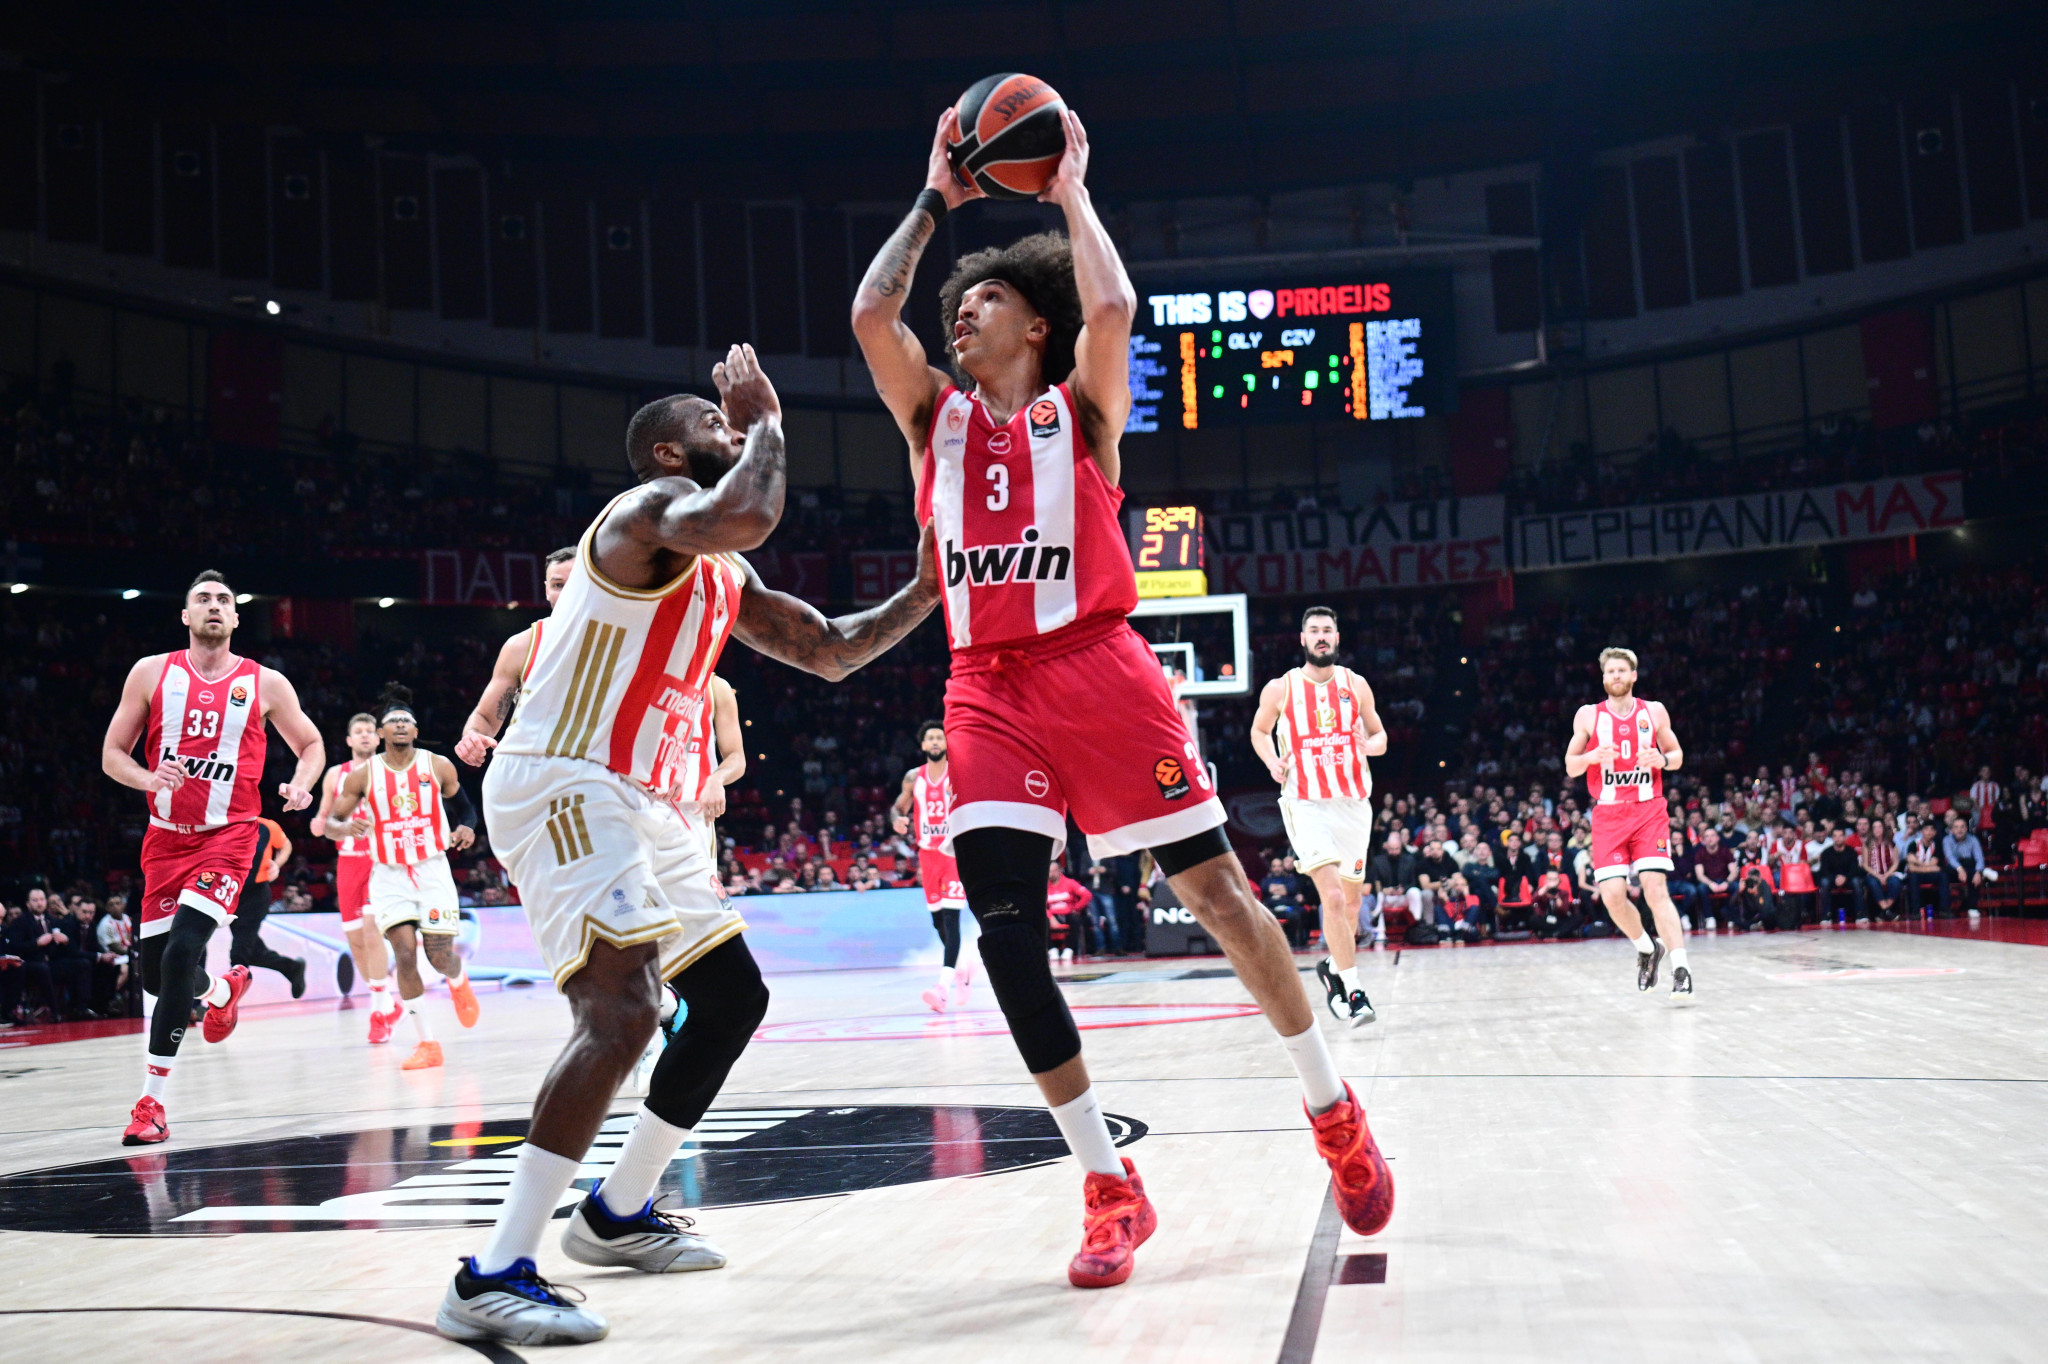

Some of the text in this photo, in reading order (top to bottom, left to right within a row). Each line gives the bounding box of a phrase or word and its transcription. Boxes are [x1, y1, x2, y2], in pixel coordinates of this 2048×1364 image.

[993, 82, 1056, 122] SPALD
[1149, 293, 1212, 326] THIS
[1218, 290, 1247, 322] IS
[1228, 328, 1315, 350] OLY CZV
[1243, 374, 1256, 392] 7
[986, 464, 1009, 512] 3
[1146, 506, 1196, 532] 5:29
[1519, 473, 1965, 568] ΠΕΡΗΦΑΝΙΑ ΜΑΣ
[946, 528, 1071, 588] bwin
[1139, 533, 1190, 567] 21
[424, 550, 540, 604] ΠΑΠ
[187, 708, 219, 738] 33
[1314, 708, 1336, 728] 12
[1302, 732, 1350, 749] meridian
[1621, 739, 1631, 760] 0
[1184, 741, 1210, 790] 3
[1313, 752, 1344, 767] mts
[1604, 766, 1650, 785] bwin
[391, 792, 419, 812] 95
[927, 801, 945, 817] 22
[383, 816, 431, 832] meridian
[922, 821, 949, 835] bwi
[393, 833, 426, 850] mts
[214, 874, 239, 907] 33
[948, 880, 964, 897] 22
[1153, 907, 1197, 925] NO
